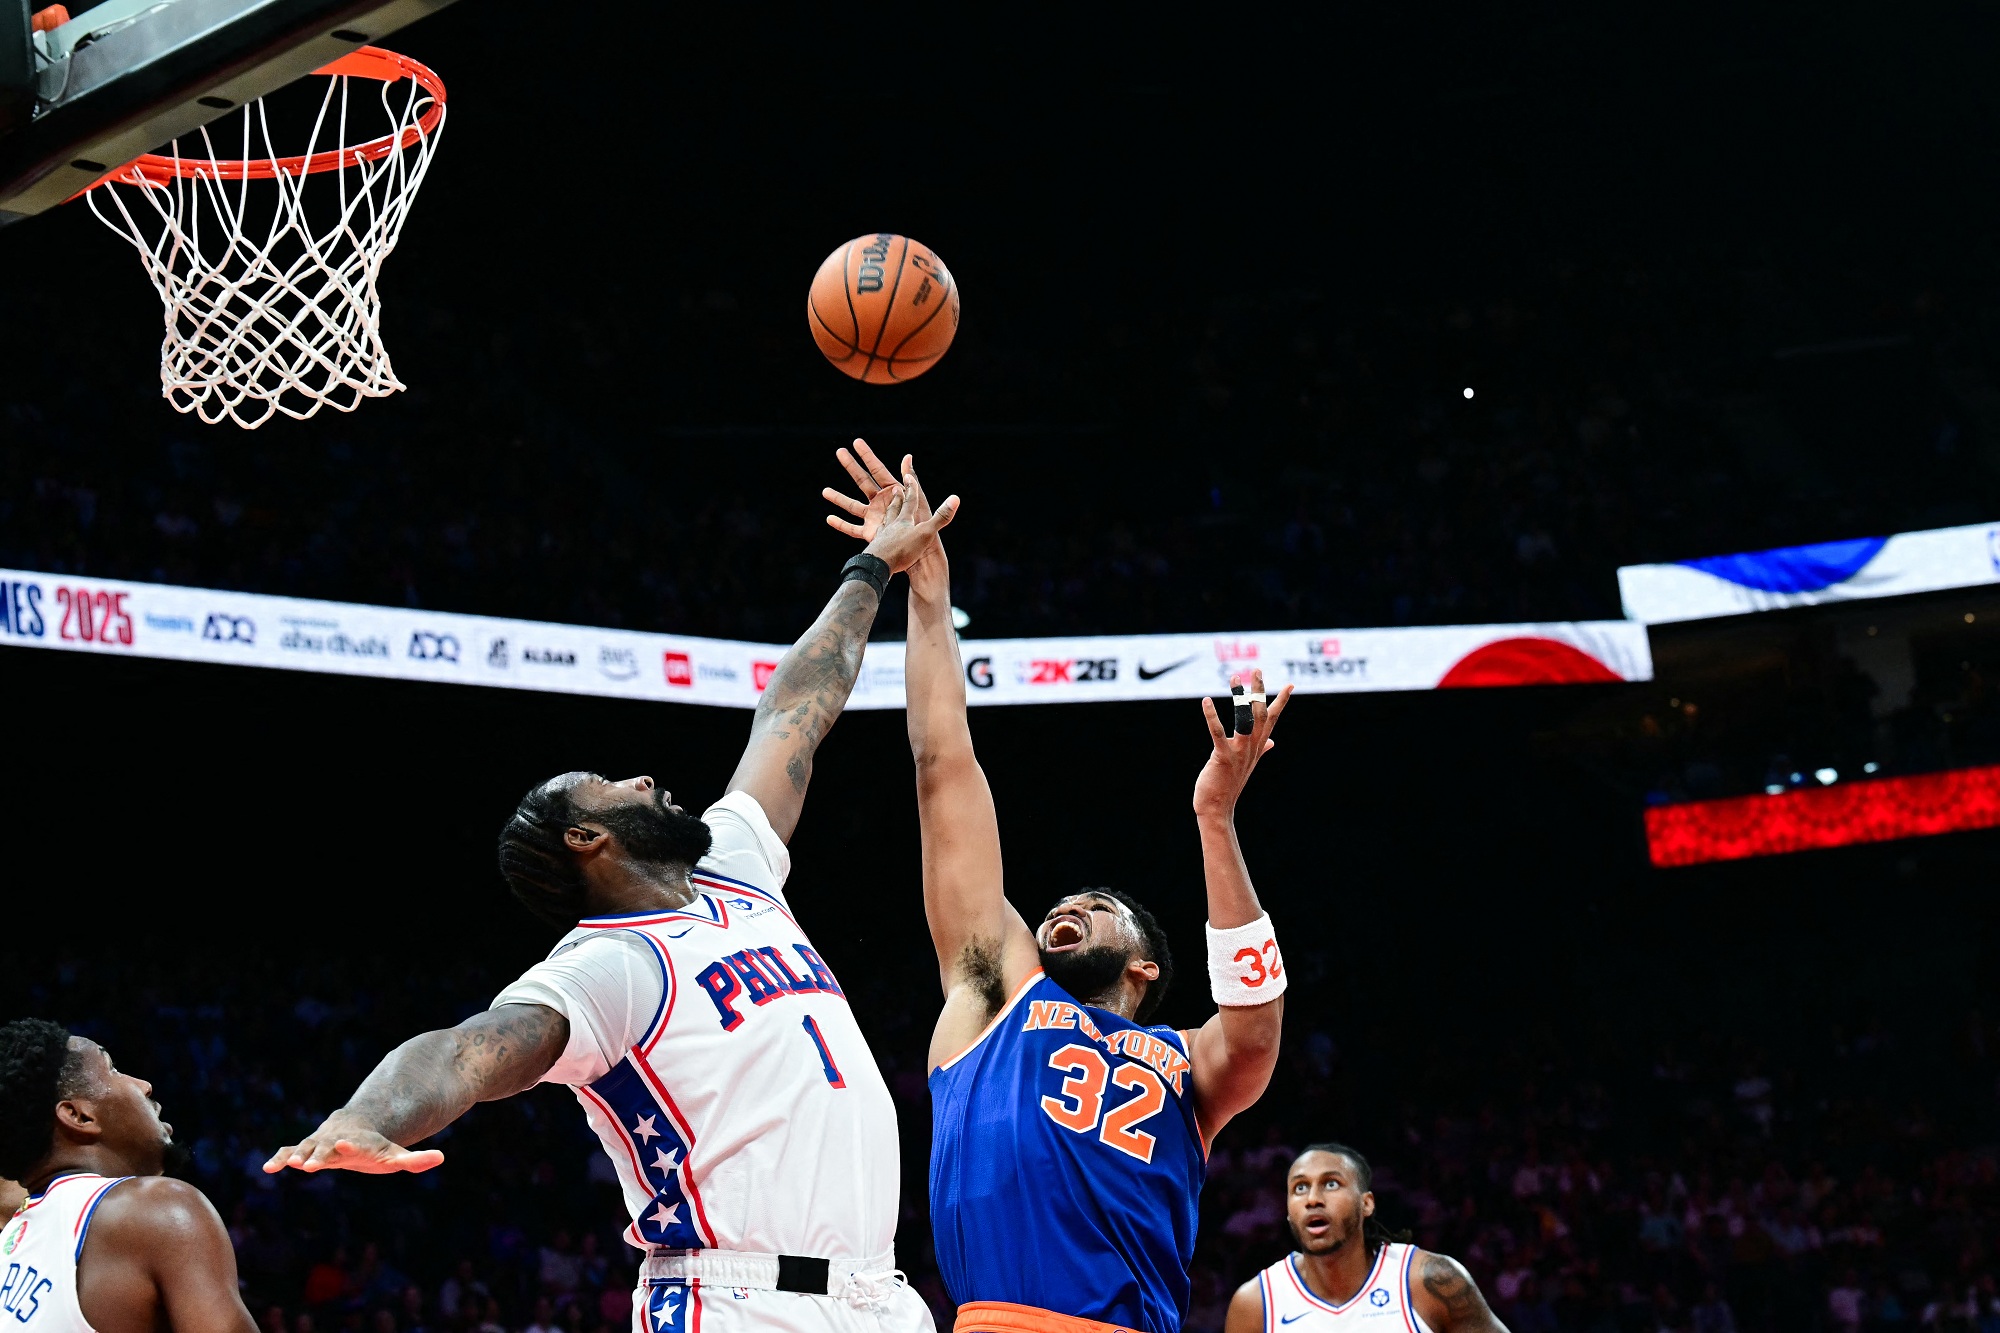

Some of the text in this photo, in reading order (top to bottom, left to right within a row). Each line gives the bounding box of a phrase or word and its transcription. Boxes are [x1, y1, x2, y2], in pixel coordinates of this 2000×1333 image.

[57, 587, 132, 645] 2025
[967, 656, 994, 689] G
[1030, 658, 1118, 685] 2K26
[1284, 656, 1369, 681] TISSOT
[694, 943, 848, 1033] PHILA
[1233, 938, 1282, 988] 32
[802, 1014, 847, 1090] 1
[1022, 999, 1192, 1099] NEW YORK
[1041, 1042, 1168, 1165] 32
